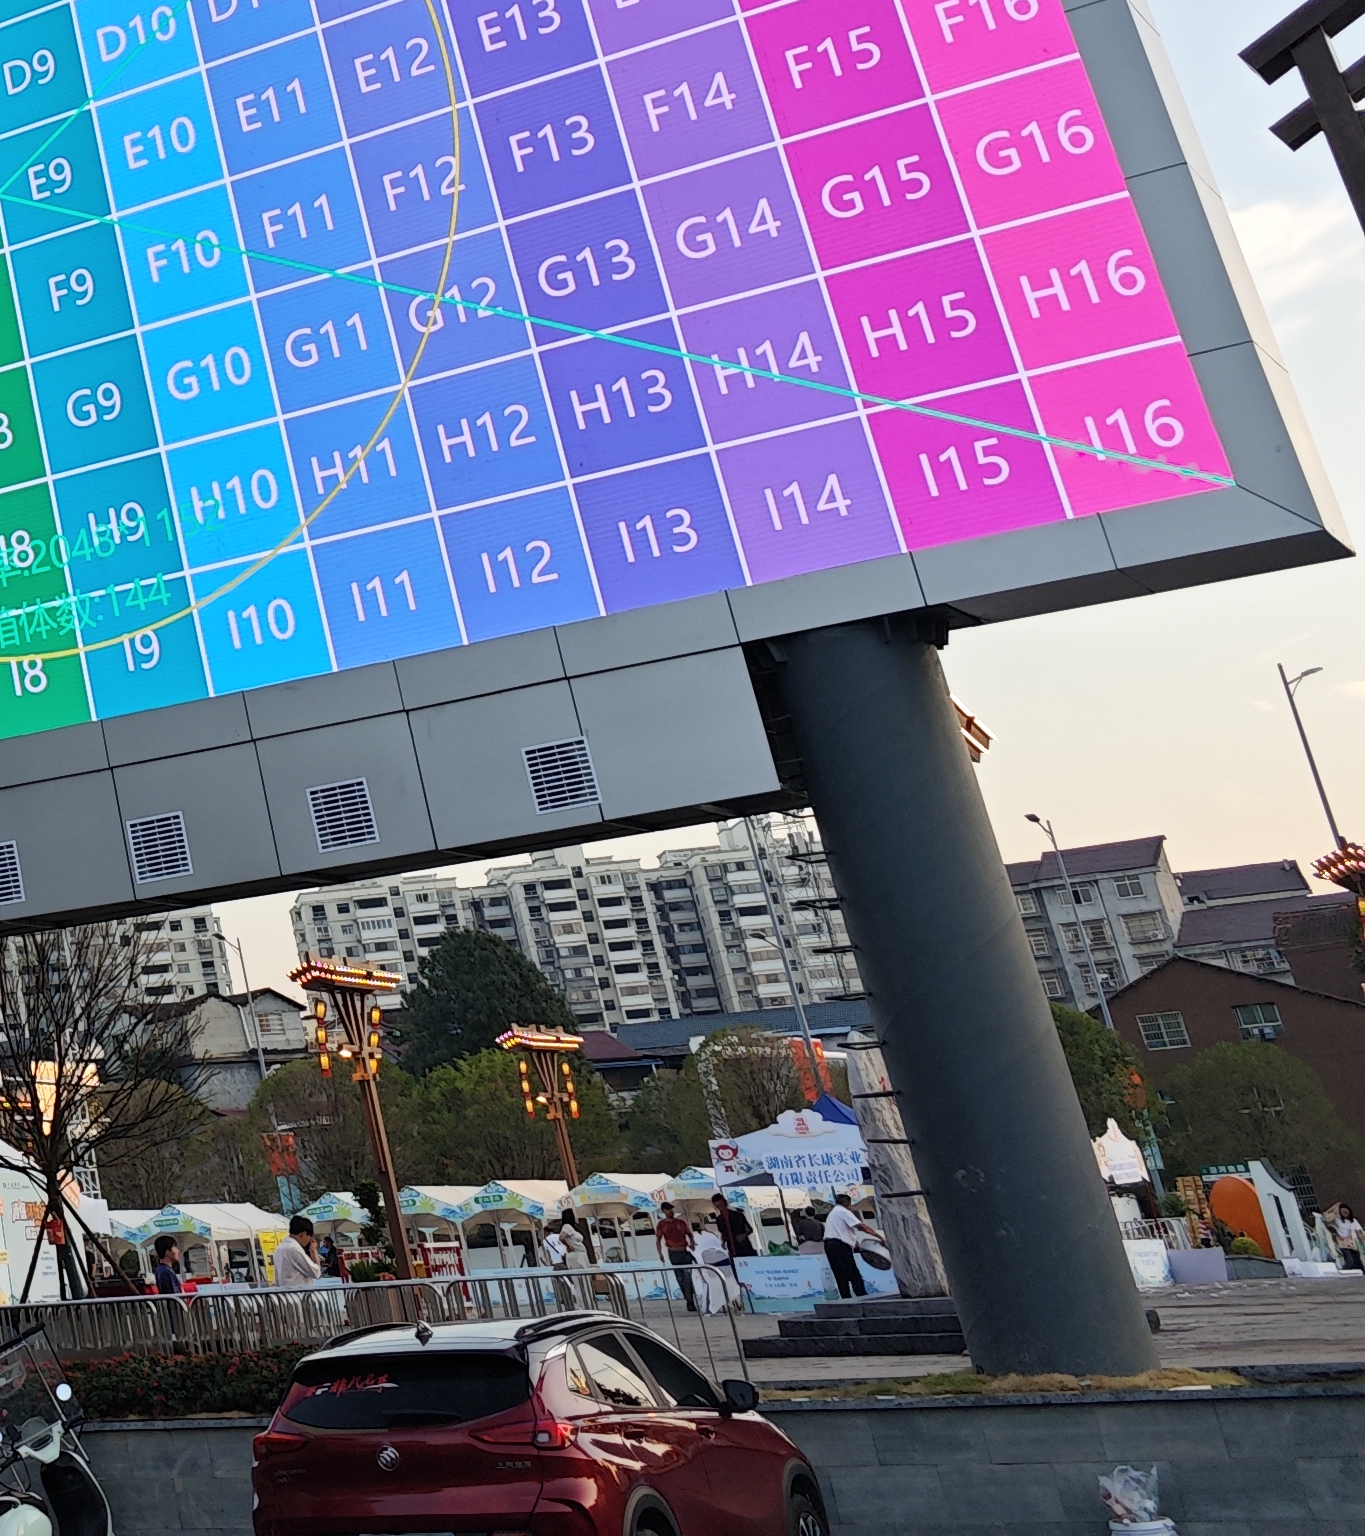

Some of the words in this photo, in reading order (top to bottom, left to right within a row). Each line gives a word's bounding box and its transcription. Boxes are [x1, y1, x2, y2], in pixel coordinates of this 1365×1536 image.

[1, 48, 55, 95] D9
[95, 4, 176, 62] D10
[27, 156, 72, 201] E9
[122, 115, 196, 170] E10
[234, 76, 307, 132] E11
[353, 36, 435, 94] E12
[47, 267, 94, 312] F9
[145, 228, 220, 283] F10
[260, 192, 334, 248] F11
[381, 154, 466, 212] F12
[508, 114, 595, 173] F13
[642, 70, 737, 132] F14
[783, 24, 881, 89] F15
[65, 381, 121, 427] G9
[165, 345, 252, 401] G10
[284, 311, 368, 368] G11
[407, 275, 501, 333] G12
[537, 237, 636, 297] G13
[675, 196, 781, 259] G14
[820, 153, 931, 218] G15
[974, 108, 1095, 176] G16
[87, 501, 145, 546] H9
[189, 467, 279, 524] H10
[310, 436, 397, 495] H11
[436, 403, 537, 463] H12
[568, 368, 672, 430] H13
[709, 330, 822, 395] H14
[859, 290, 977, 358] H15
[1019, 248, 1146, 319] H16
[9, 653, 48, 696] I8
[121, 628, 160, 672] I9
[226, 597, 296, 649] I10
[350, 568, 416, 622] I11
[480, 539, 559, 593] I12
[617, 507, 698, 563] I13
[763, 472, 851, 531] I14
[918, 436, 1010, 497] I15
[1083, 398, 1184, 462] I16
